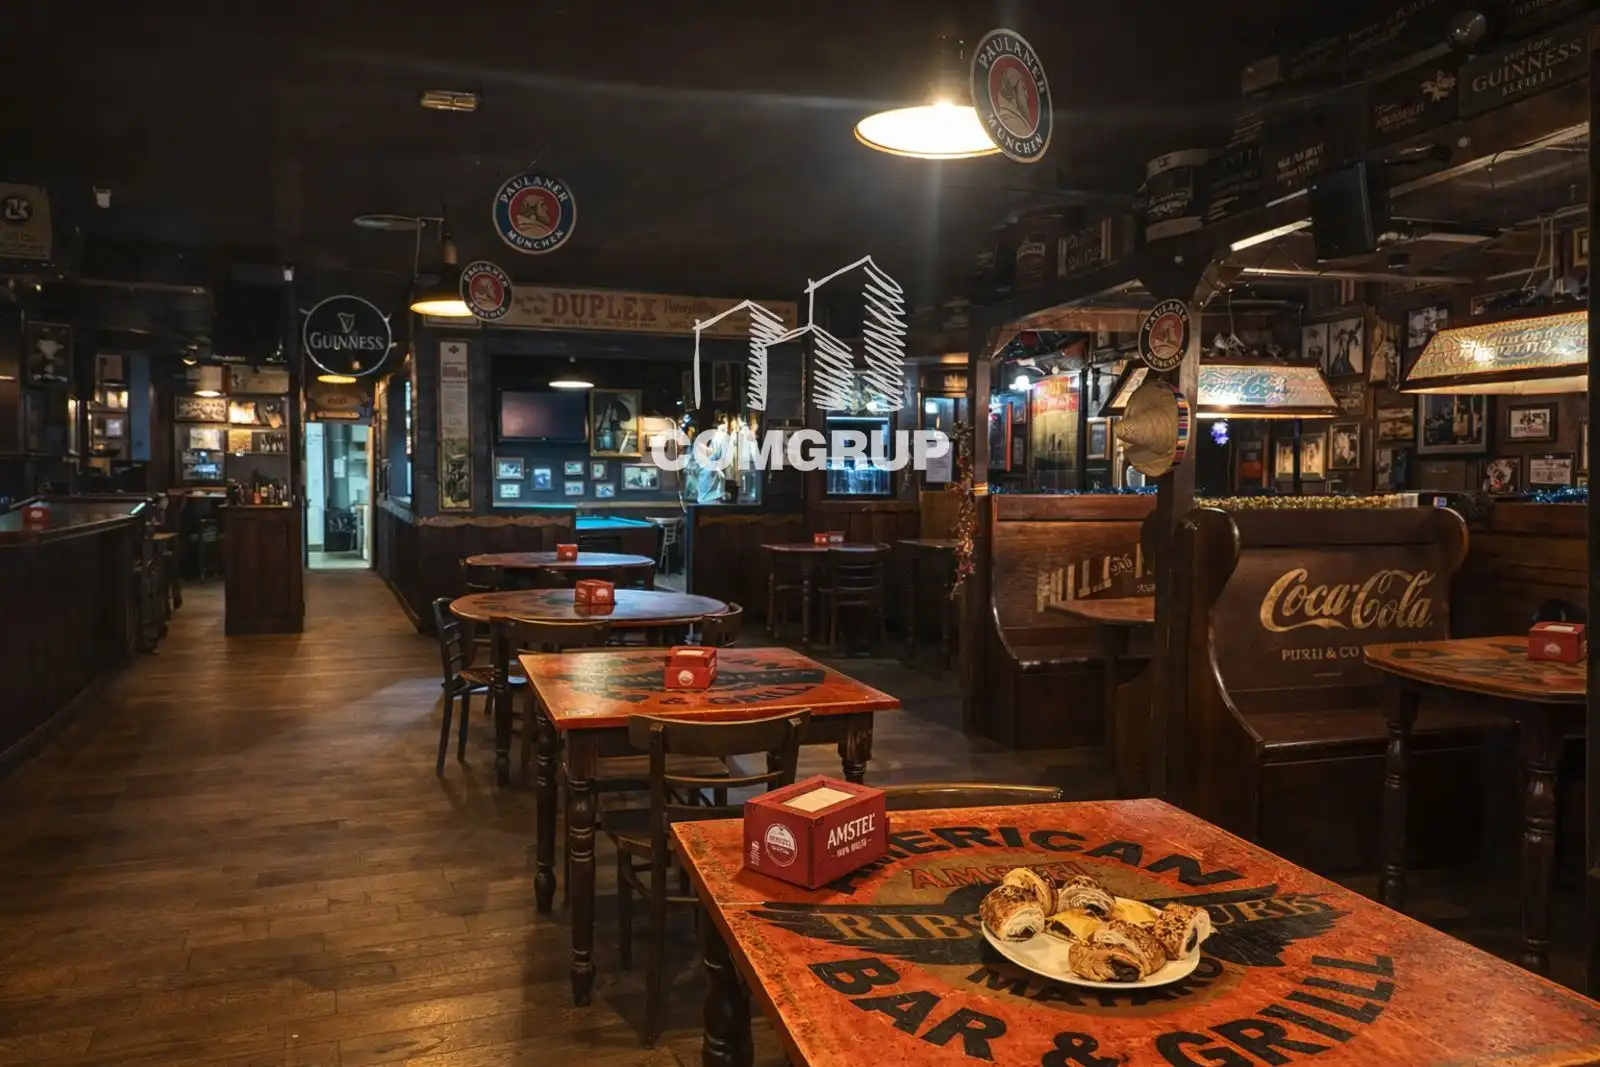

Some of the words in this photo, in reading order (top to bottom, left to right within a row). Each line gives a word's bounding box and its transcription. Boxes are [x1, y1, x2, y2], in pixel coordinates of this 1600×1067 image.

[978, 37, 1046, 93] PAULANER
[1471, 38, 1582, 93] GUINNESS
[500, 175, 569, 203] PAULANER
[550, 292, 658, 322] DUPLEX
[309, 332, 384, 351] GUINNESS
[827, 813, 876, 850] AMSTEL
[818, 912, 980, 940] RIB
[805, 956, 1008, 1063] BAR
[1155, 954, 1395, 1067] GRILL
